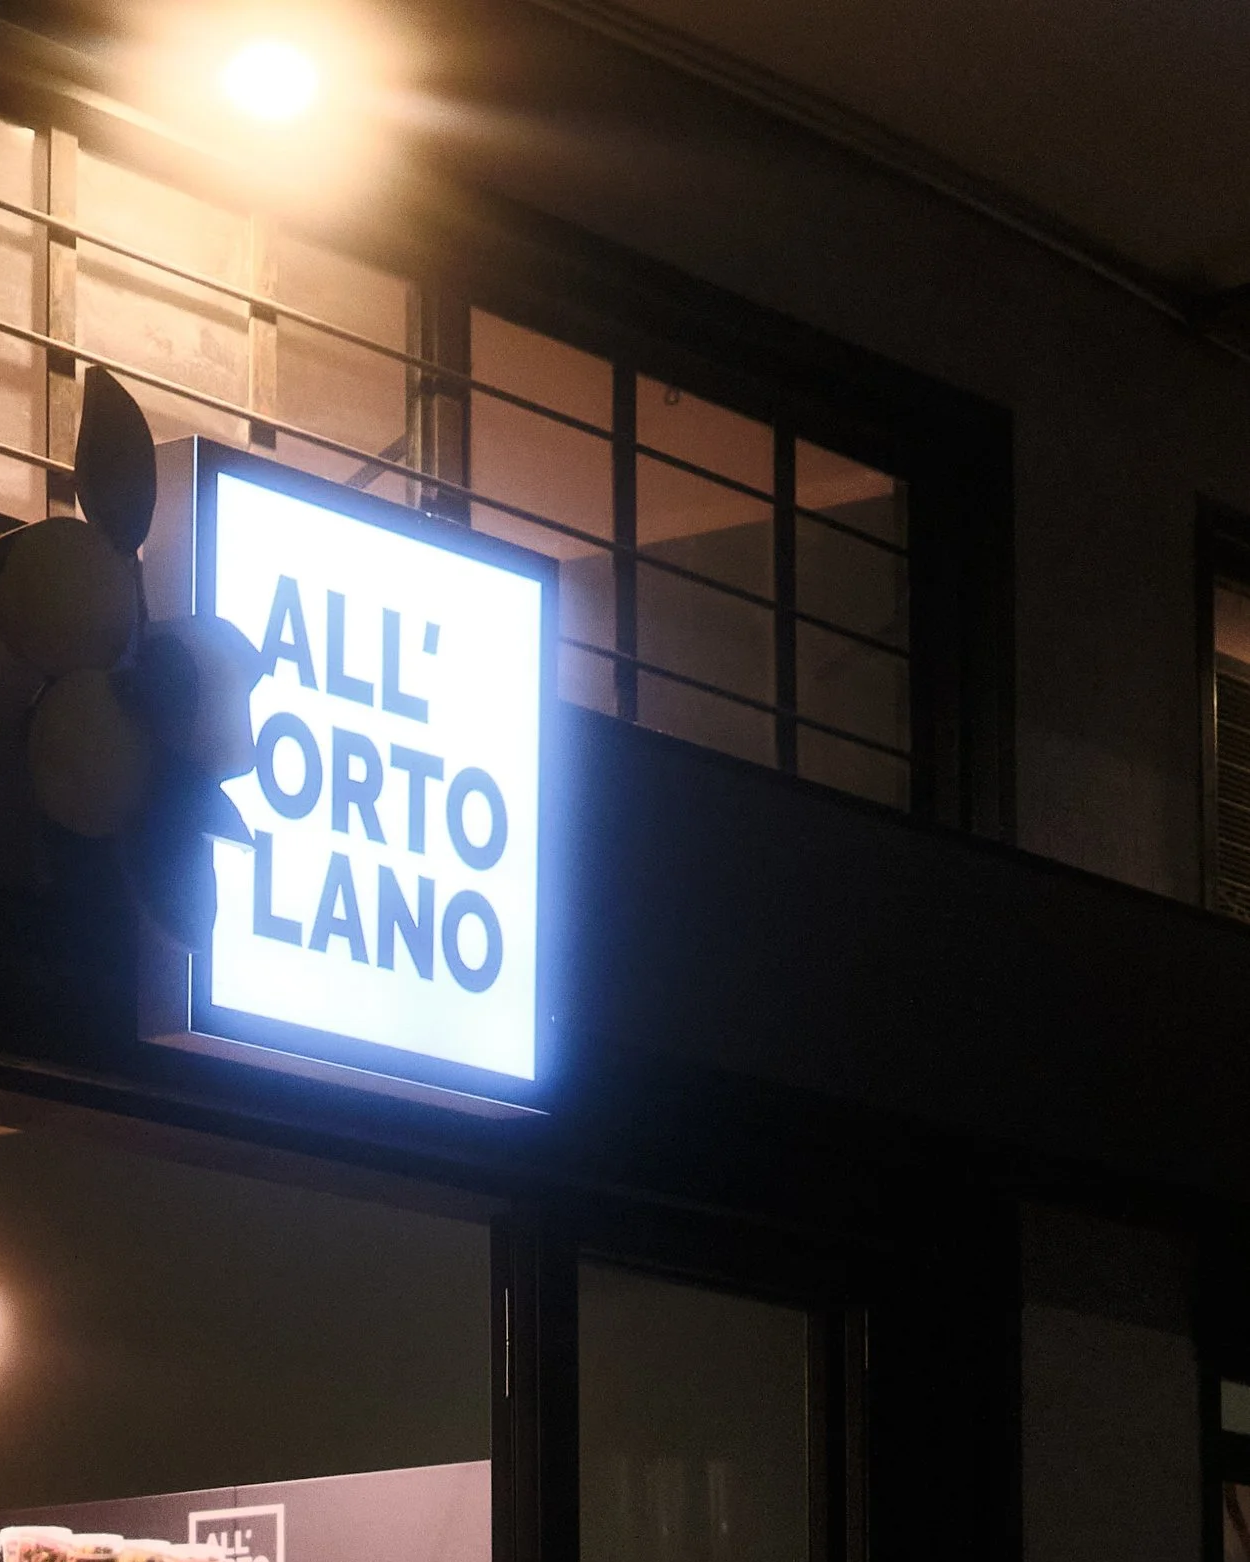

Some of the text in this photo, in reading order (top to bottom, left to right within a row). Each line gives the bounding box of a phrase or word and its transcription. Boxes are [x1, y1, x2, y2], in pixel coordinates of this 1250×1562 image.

[260, 573, 440, 724] ALL'
[255, 711, 508, 871] ORTO
[253, 829, 503, 994] LANO
